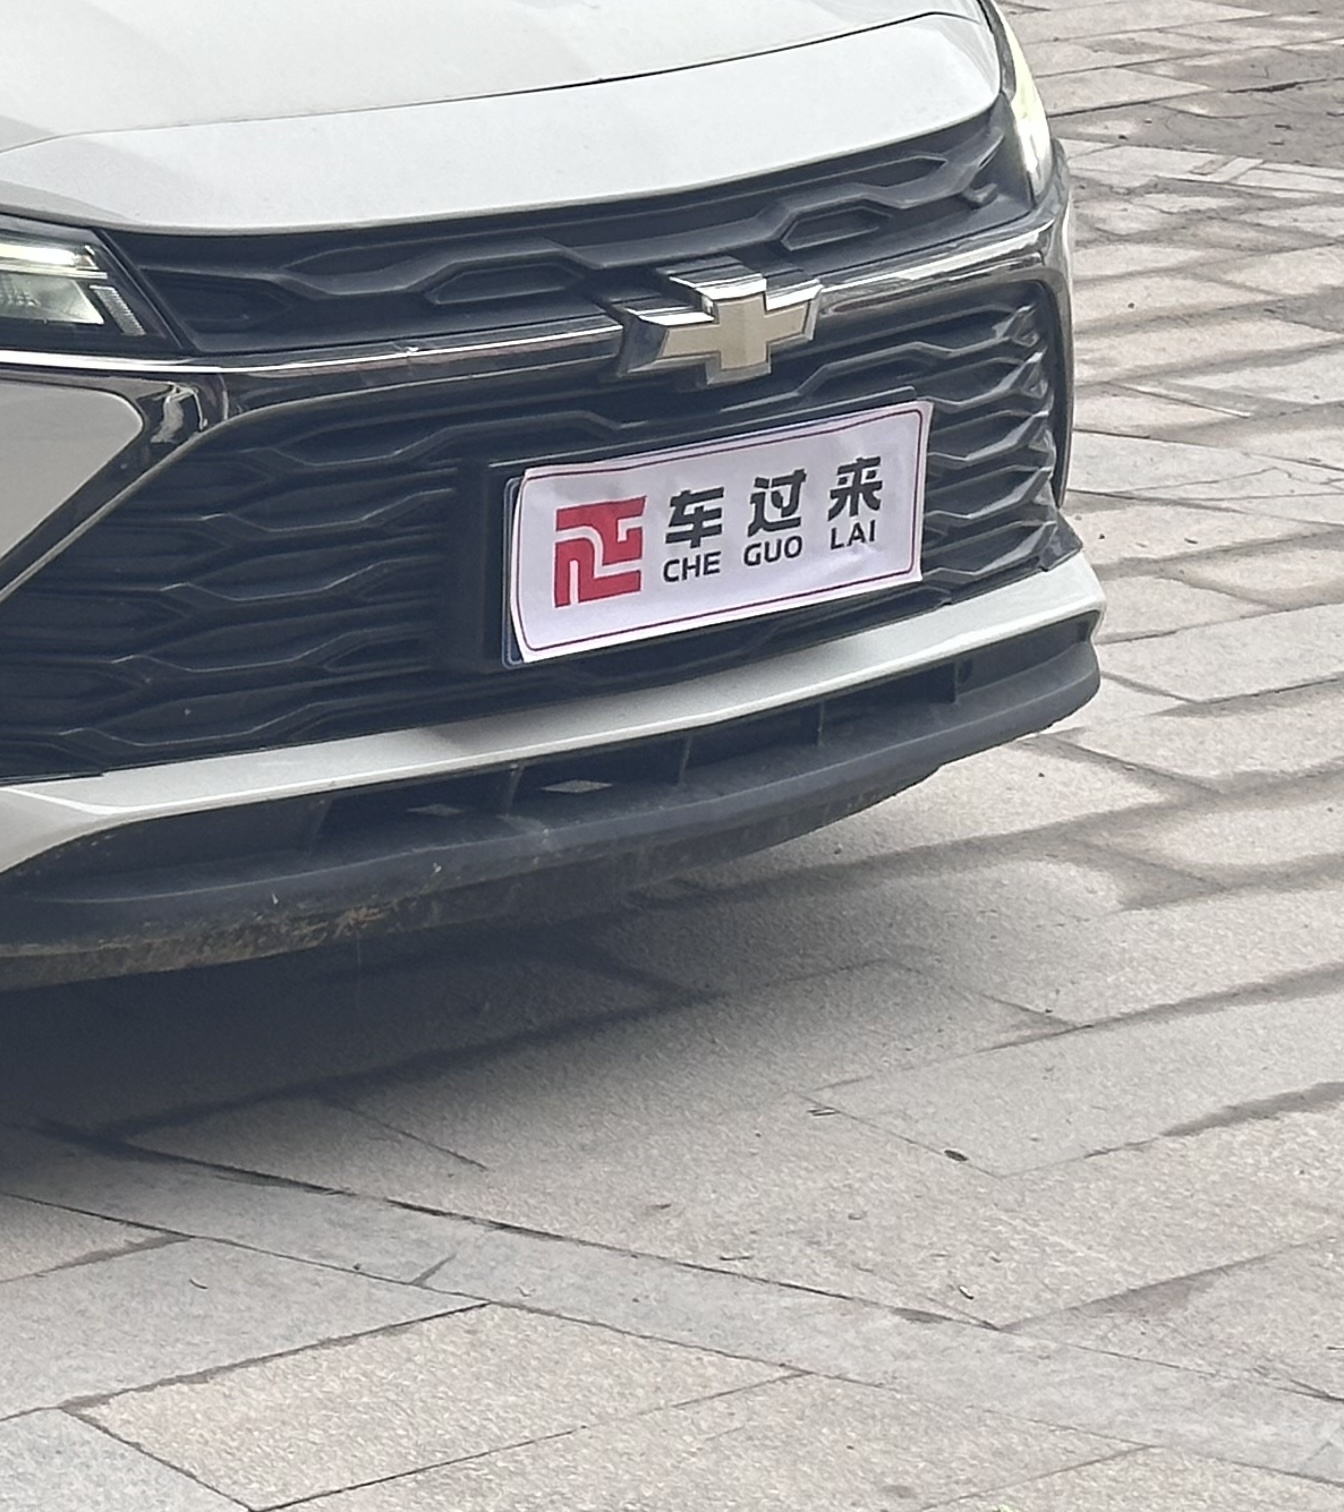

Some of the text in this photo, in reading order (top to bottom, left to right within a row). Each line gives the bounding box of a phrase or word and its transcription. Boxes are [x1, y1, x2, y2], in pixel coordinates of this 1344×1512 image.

[664, 456, 883, 549] 车过来
[662, 518, 877, 585] CHE GUO LAI
